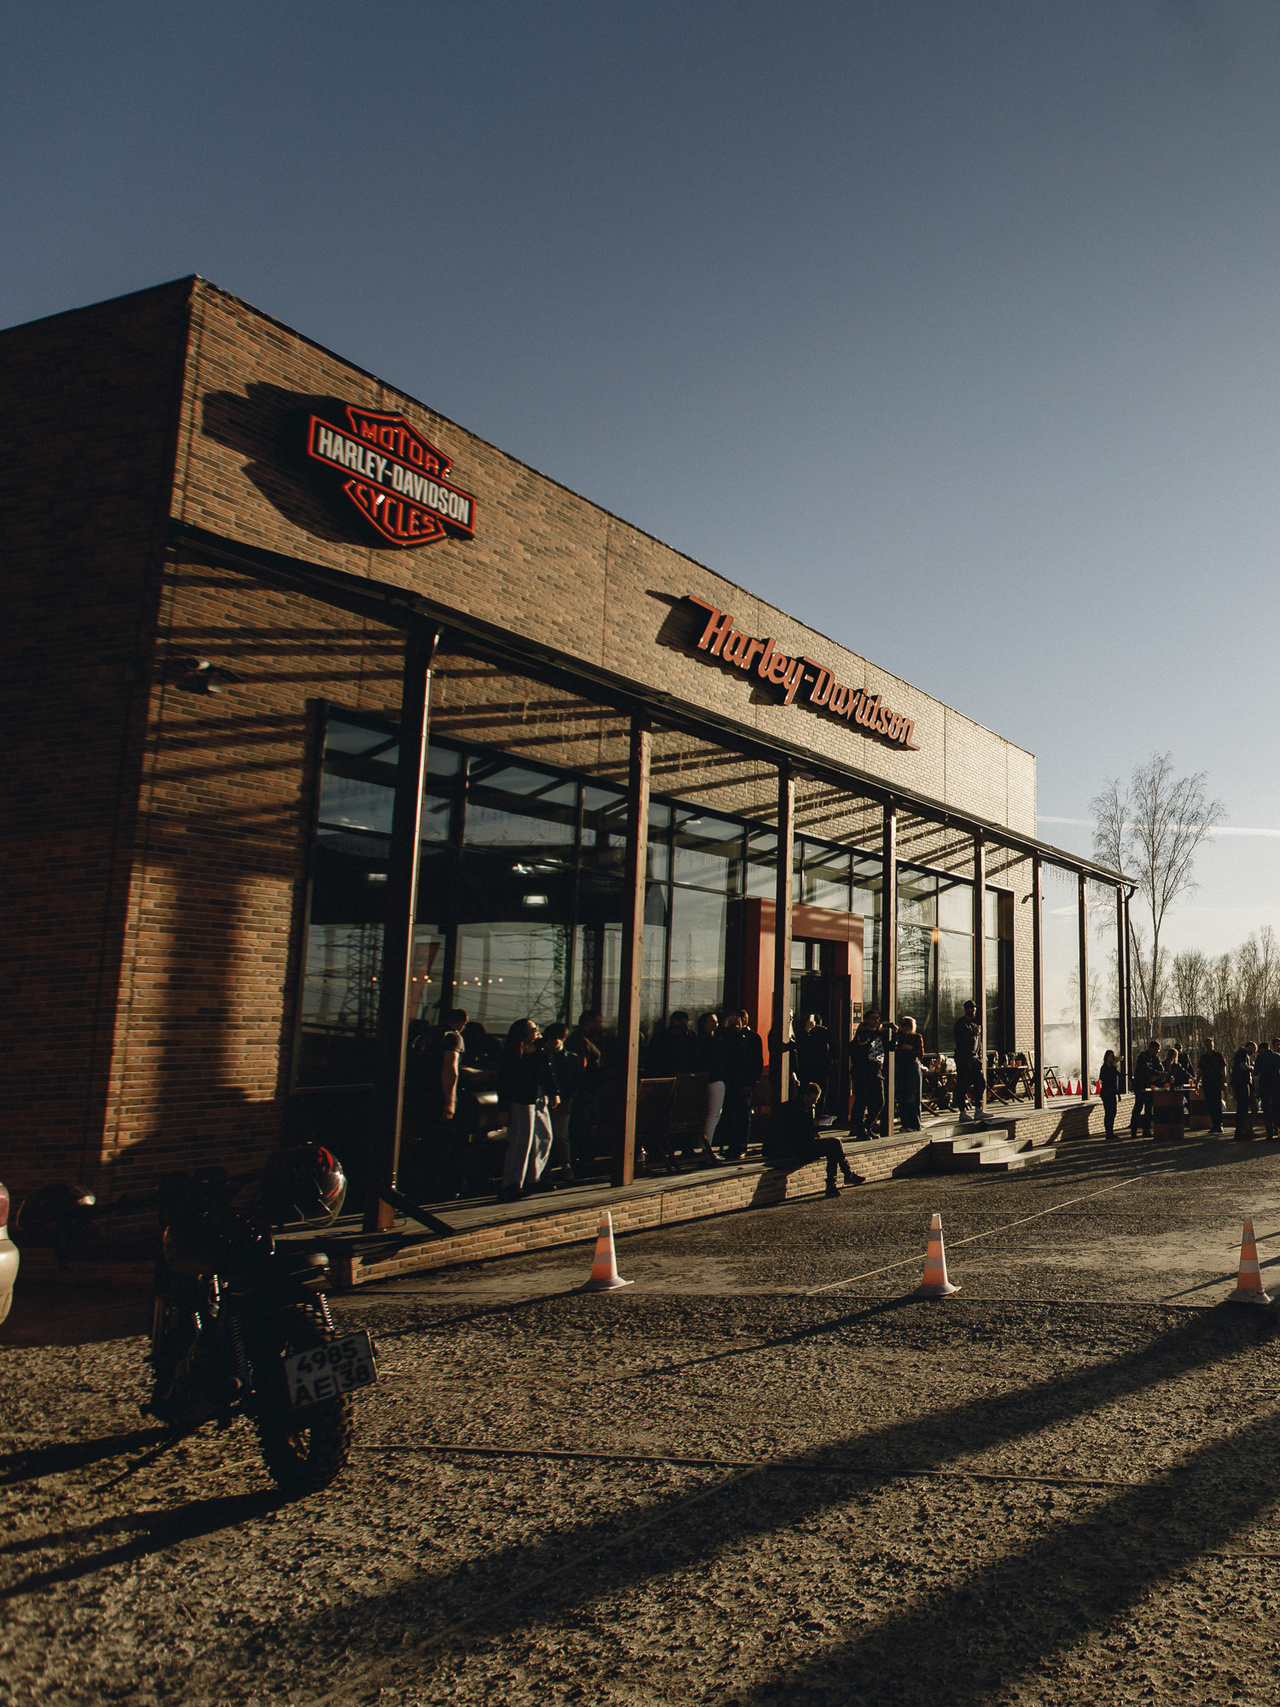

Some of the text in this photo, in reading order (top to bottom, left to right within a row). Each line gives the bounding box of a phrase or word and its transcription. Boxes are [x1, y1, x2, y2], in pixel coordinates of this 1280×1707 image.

[317, 425, 470, 525] HARLEY-DAVIDSON
[360, 419, 439, 476] MOTOR
[354, 481, 435, 537] CYCLES
[688, 594, 921, 751] Harley-Davidson
[297, 1340, 358, 1373] 4985
[340, 1364, 370, 1388] 38
